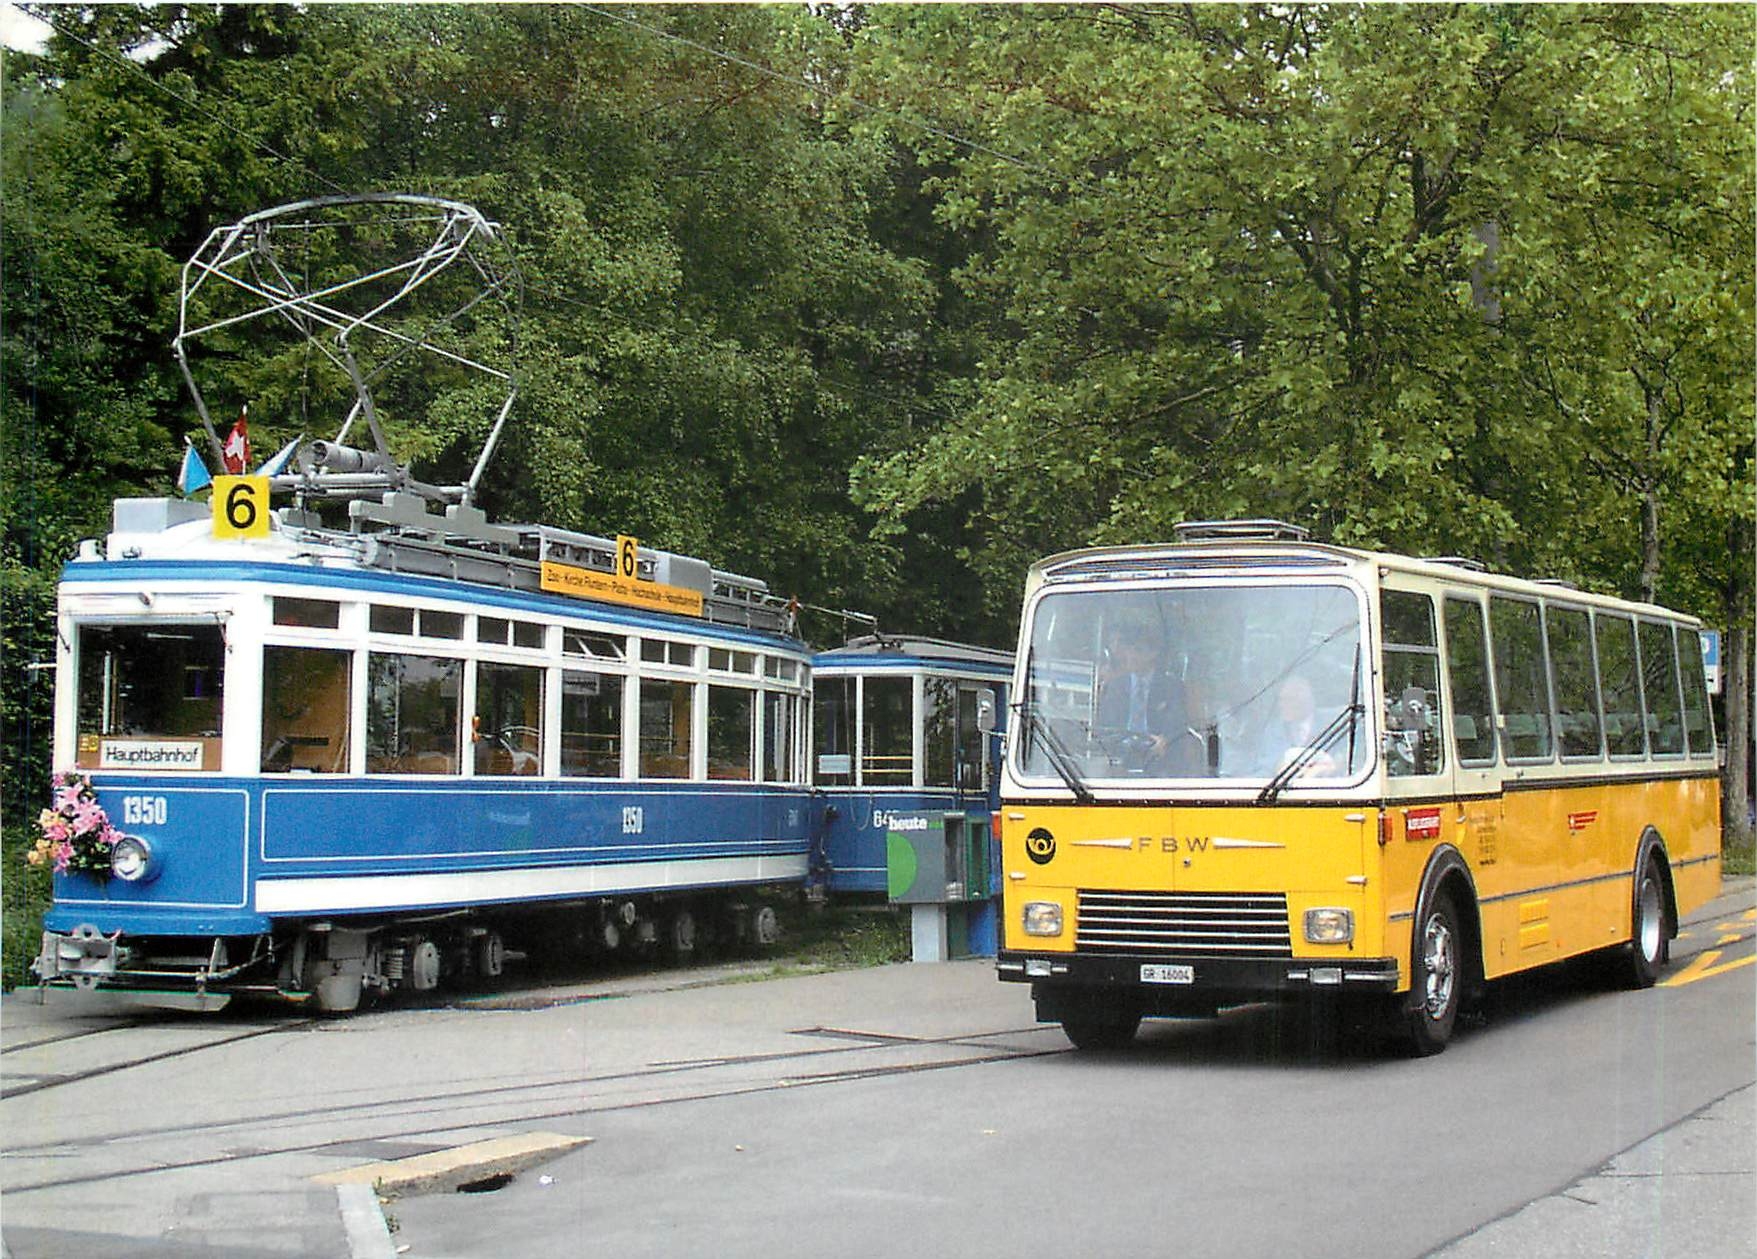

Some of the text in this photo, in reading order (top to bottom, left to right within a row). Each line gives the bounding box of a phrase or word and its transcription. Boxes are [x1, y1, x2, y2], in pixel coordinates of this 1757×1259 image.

[226, 484, 256, 529] 6
[623, 540, 634, 577] 6
[106, 746, 199, 764] Hauptbahnhof
[123, 796, 168, 825] 1350
[622, 806, 643, 833] 1350
[888, 815, 928, 831] heute
